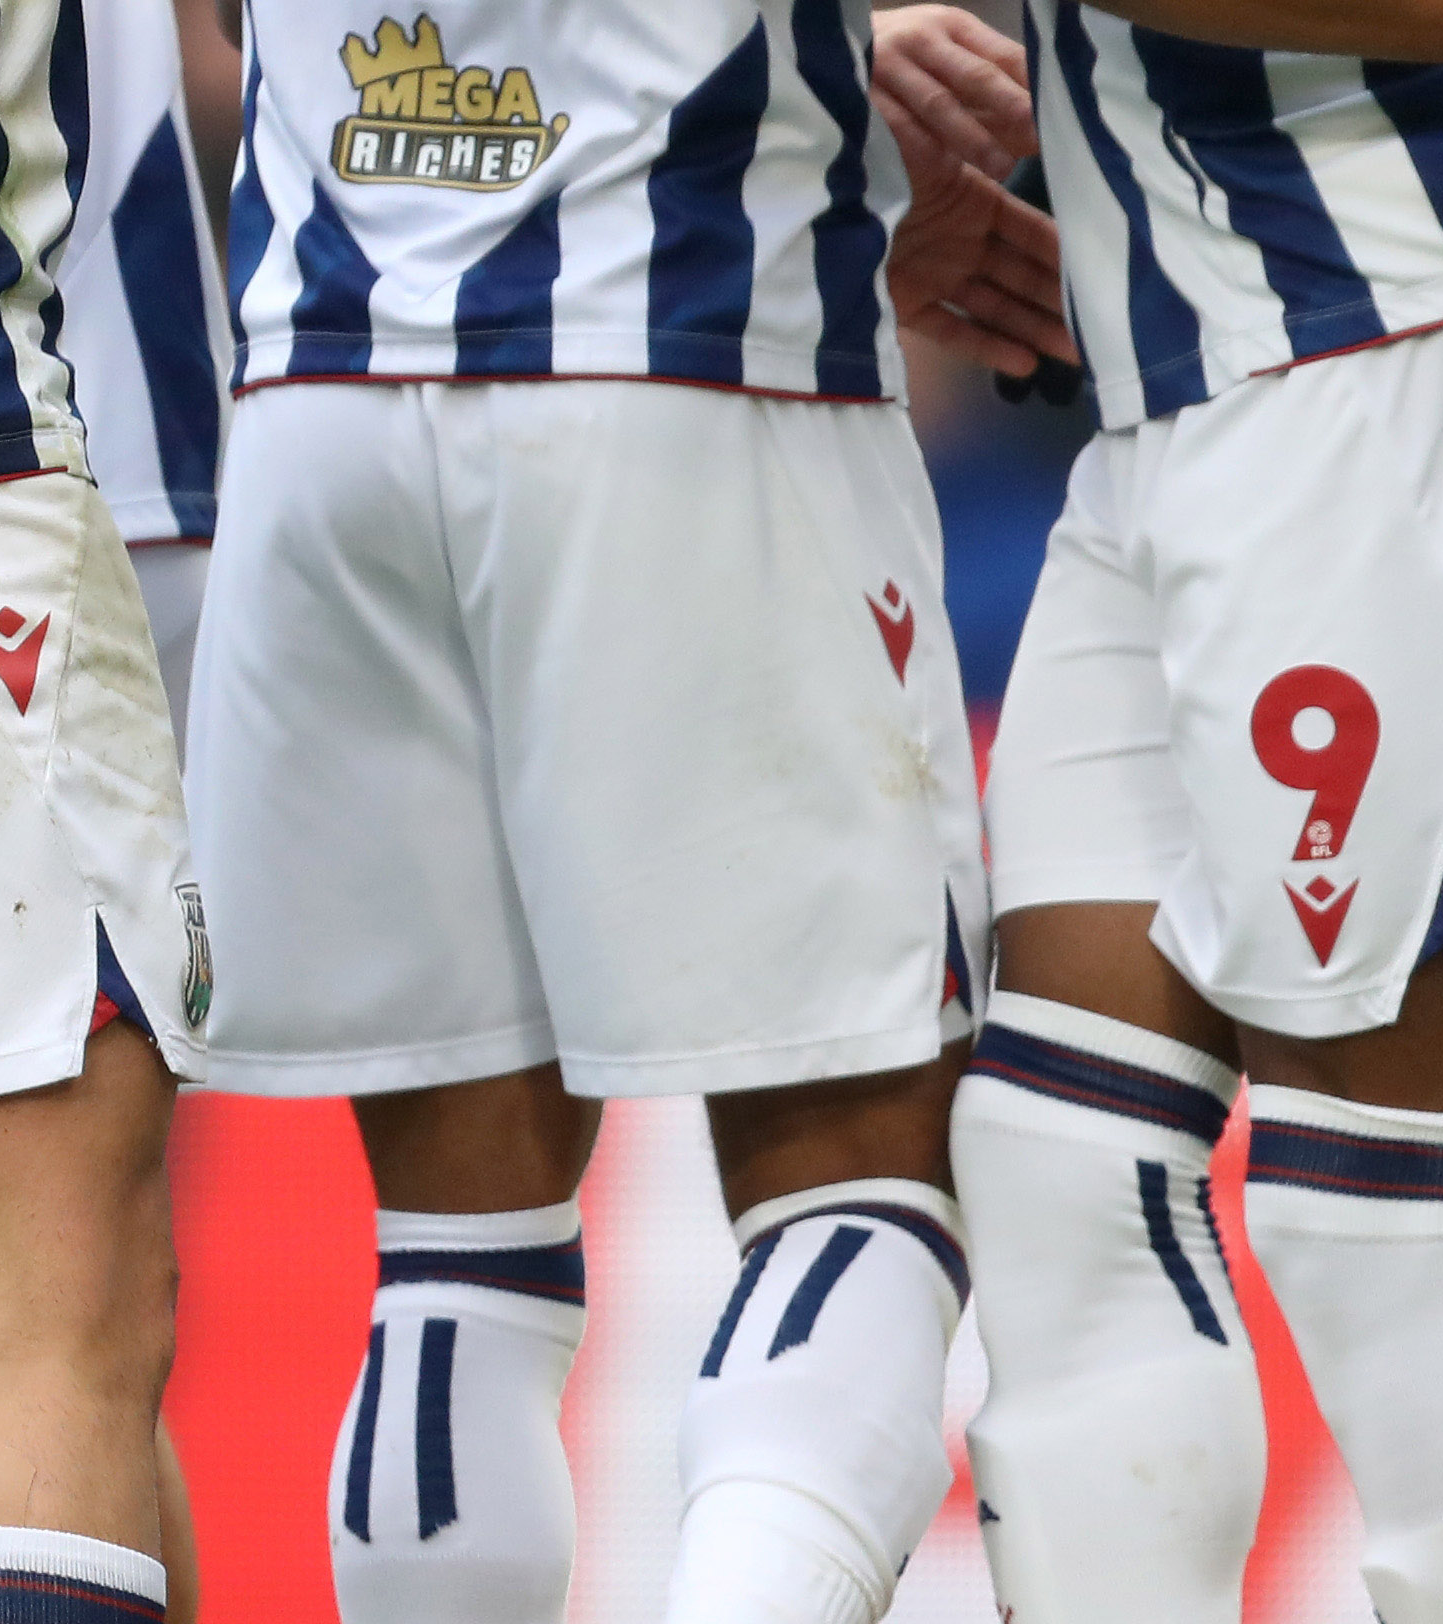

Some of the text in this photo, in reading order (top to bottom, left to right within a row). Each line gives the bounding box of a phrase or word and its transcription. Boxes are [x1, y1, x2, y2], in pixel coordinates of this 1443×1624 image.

[359, 65, 543, 126] MEGA
[349, 130, 537, 183] RICHES
[1249, 663, 1381, 862] 9
[1309, 844, 1333, 858] EFL
